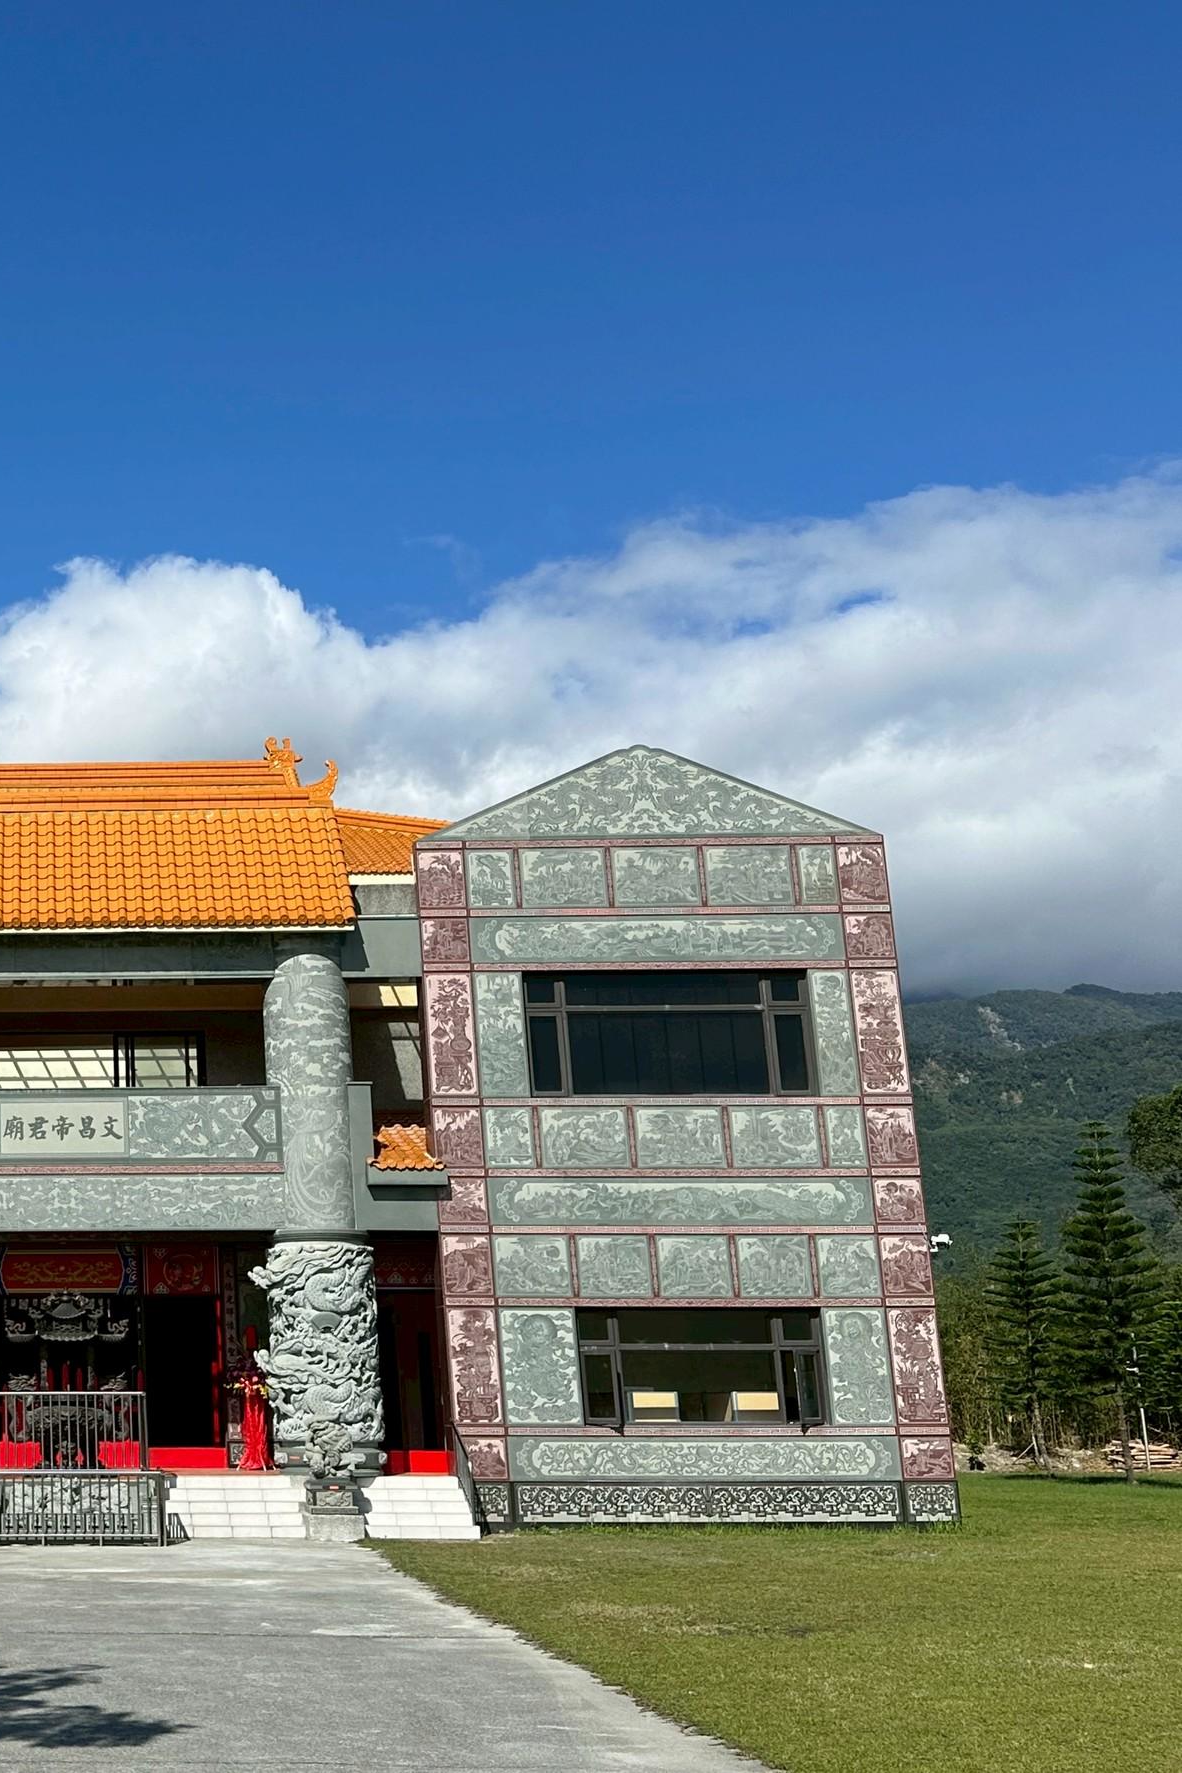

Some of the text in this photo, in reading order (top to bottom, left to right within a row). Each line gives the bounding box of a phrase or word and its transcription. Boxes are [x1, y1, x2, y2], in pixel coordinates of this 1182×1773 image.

[3, 1115, 123, 1141] 文昌帝君廟
